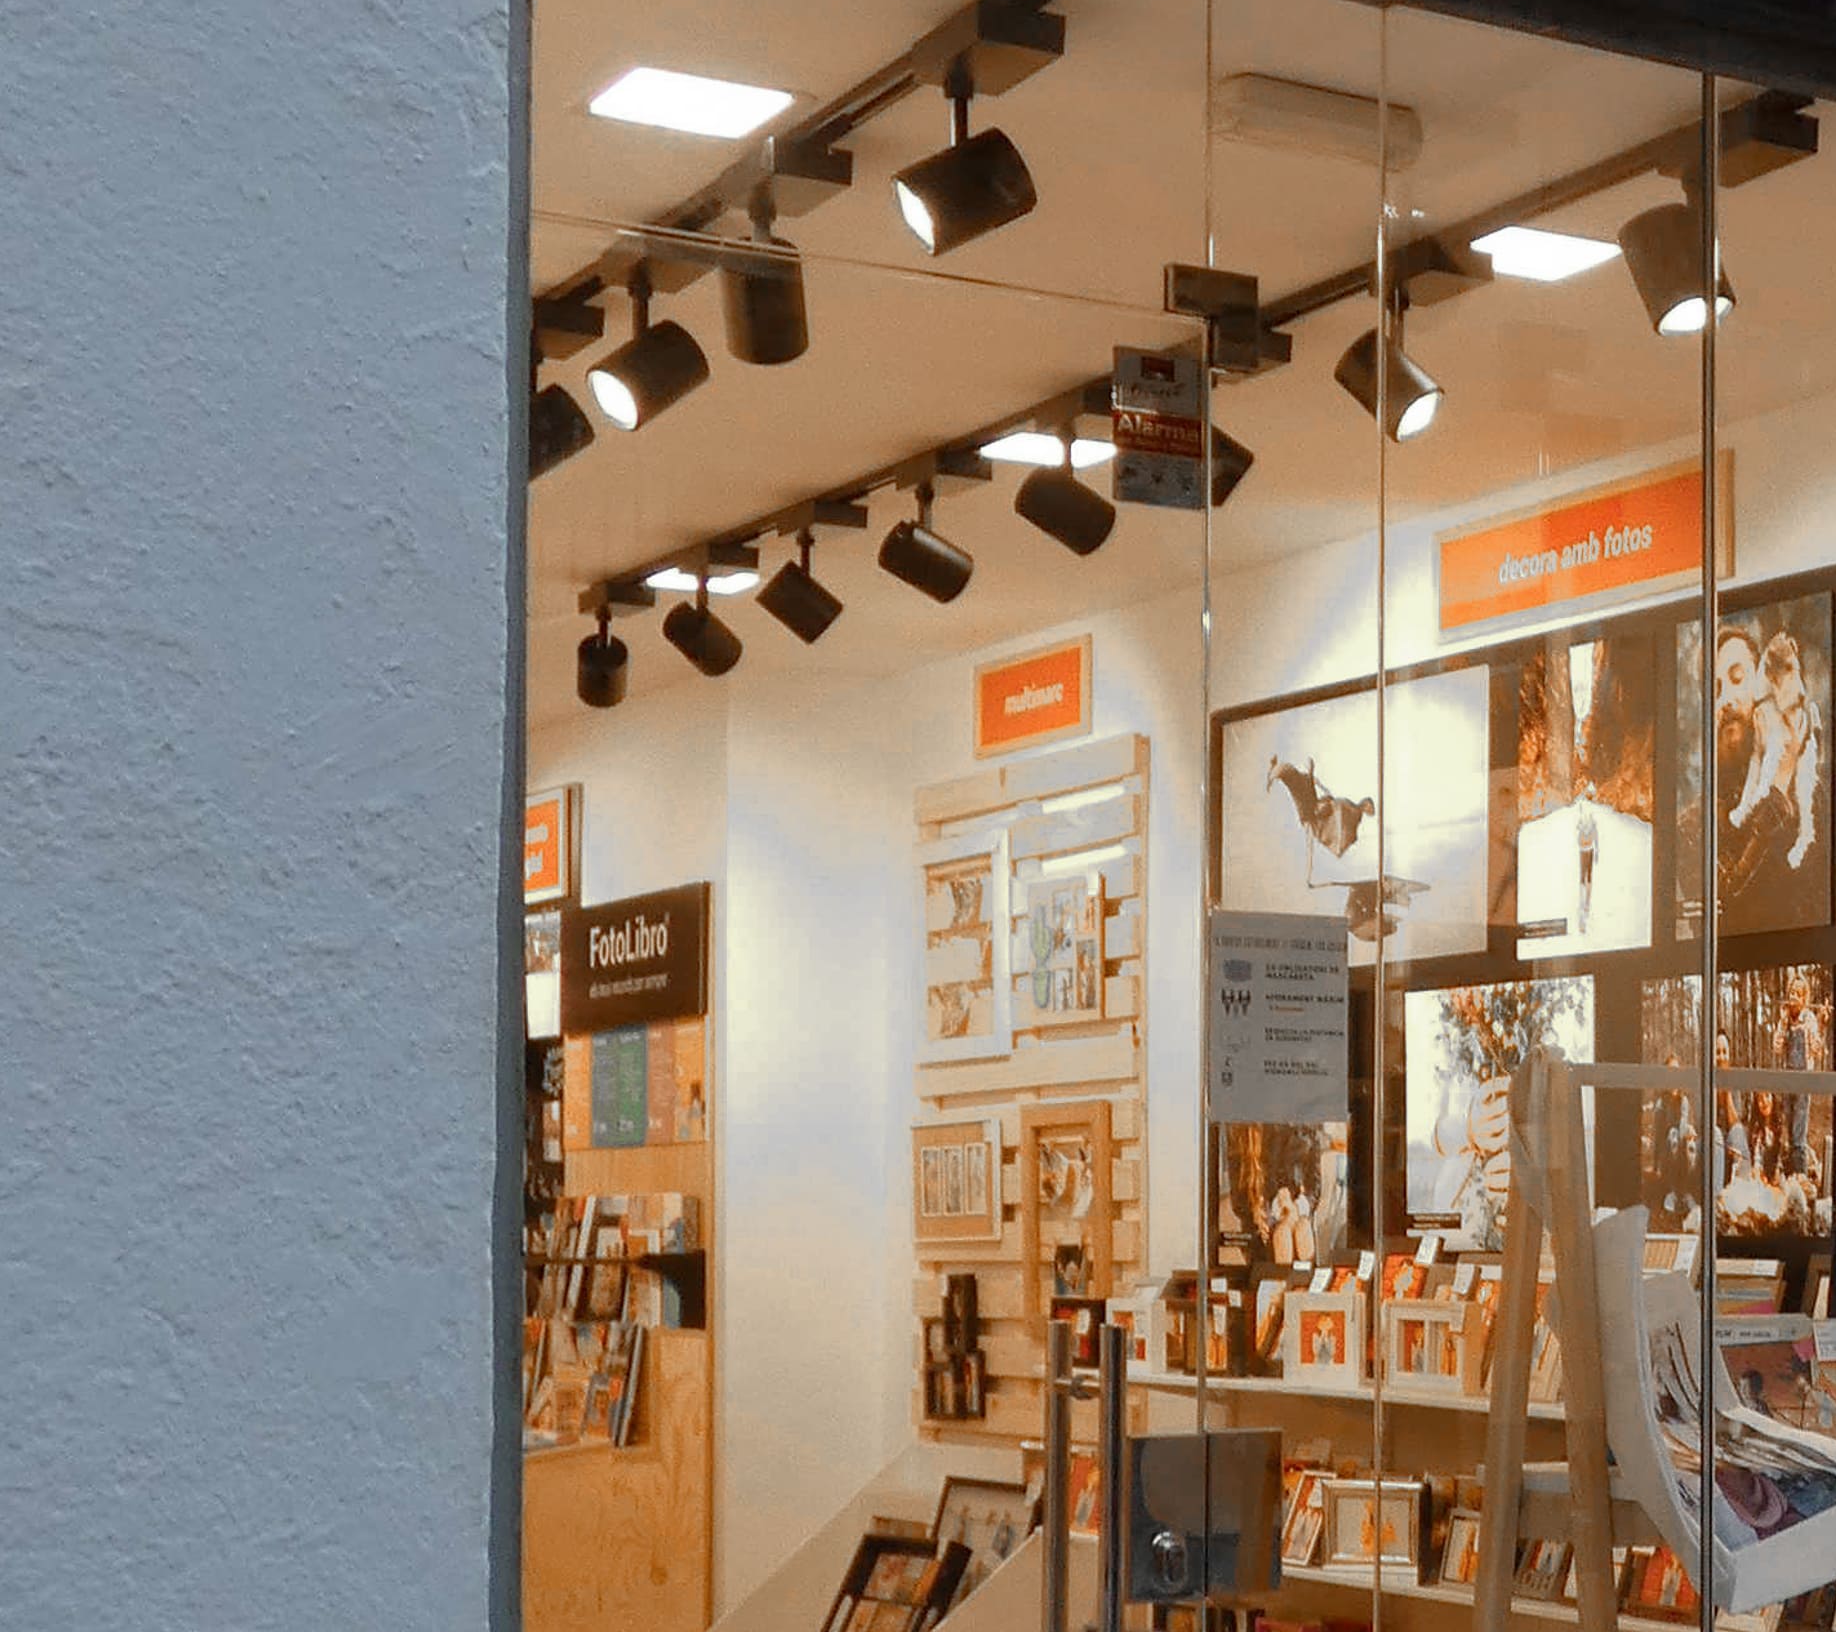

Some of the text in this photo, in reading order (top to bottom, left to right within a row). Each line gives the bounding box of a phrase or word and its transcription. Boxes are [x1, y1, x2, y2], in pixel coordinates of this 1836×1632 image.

[1497, 524, 1654, 585] decora amb fotos
